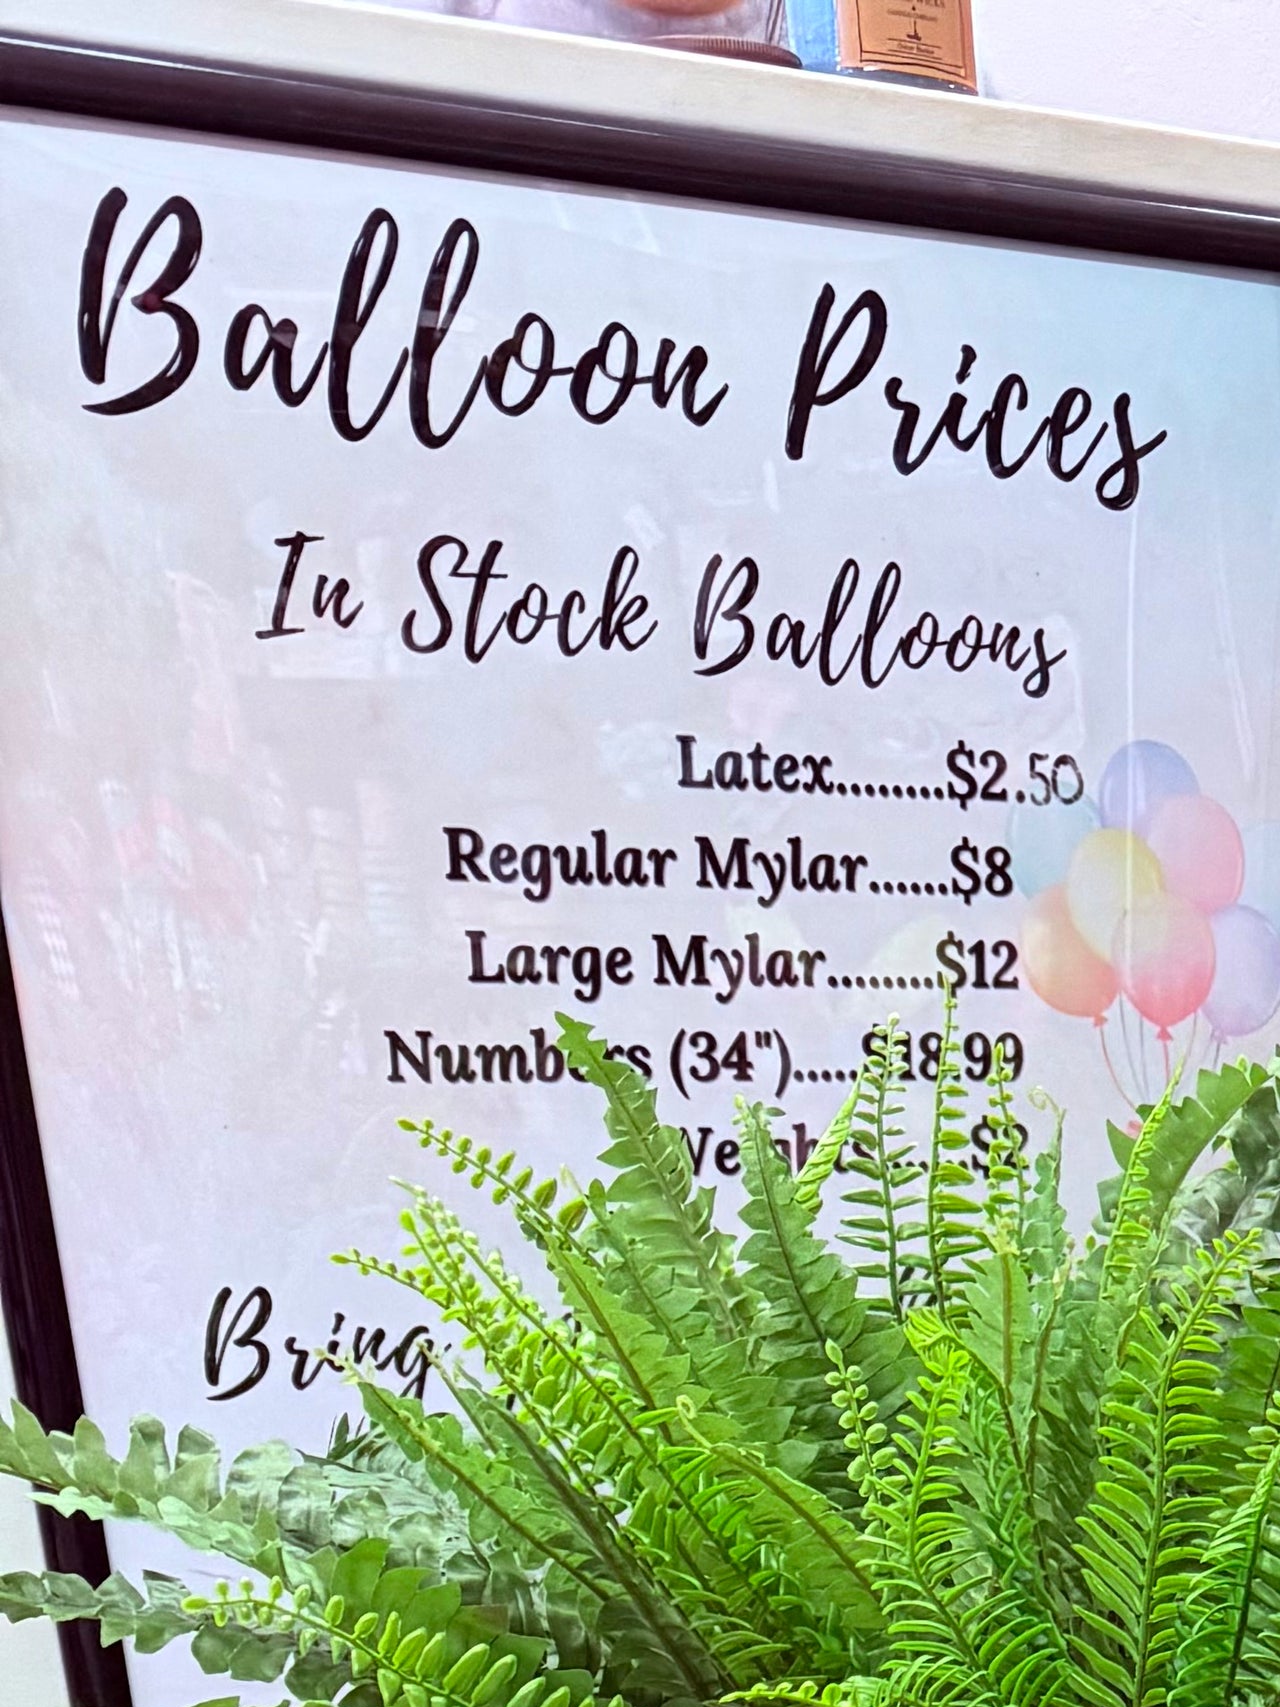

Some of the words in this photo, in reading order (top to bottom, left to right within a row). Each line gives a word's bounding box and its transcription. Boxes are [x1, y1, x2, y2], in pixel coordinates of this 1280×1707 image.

[77, 187, 729, 450] Balloon
[785, 282, 1168, 511] Prices
[255, 530, 364, 640] In
[401, 534, 659, 664] Stock
[693, 553, 1067, 699] Balloons
[442, 826, 678, 903] Regular
[465, 930, 634, 1003] Large
[383, 1027, 653, 1084] Numbrs
